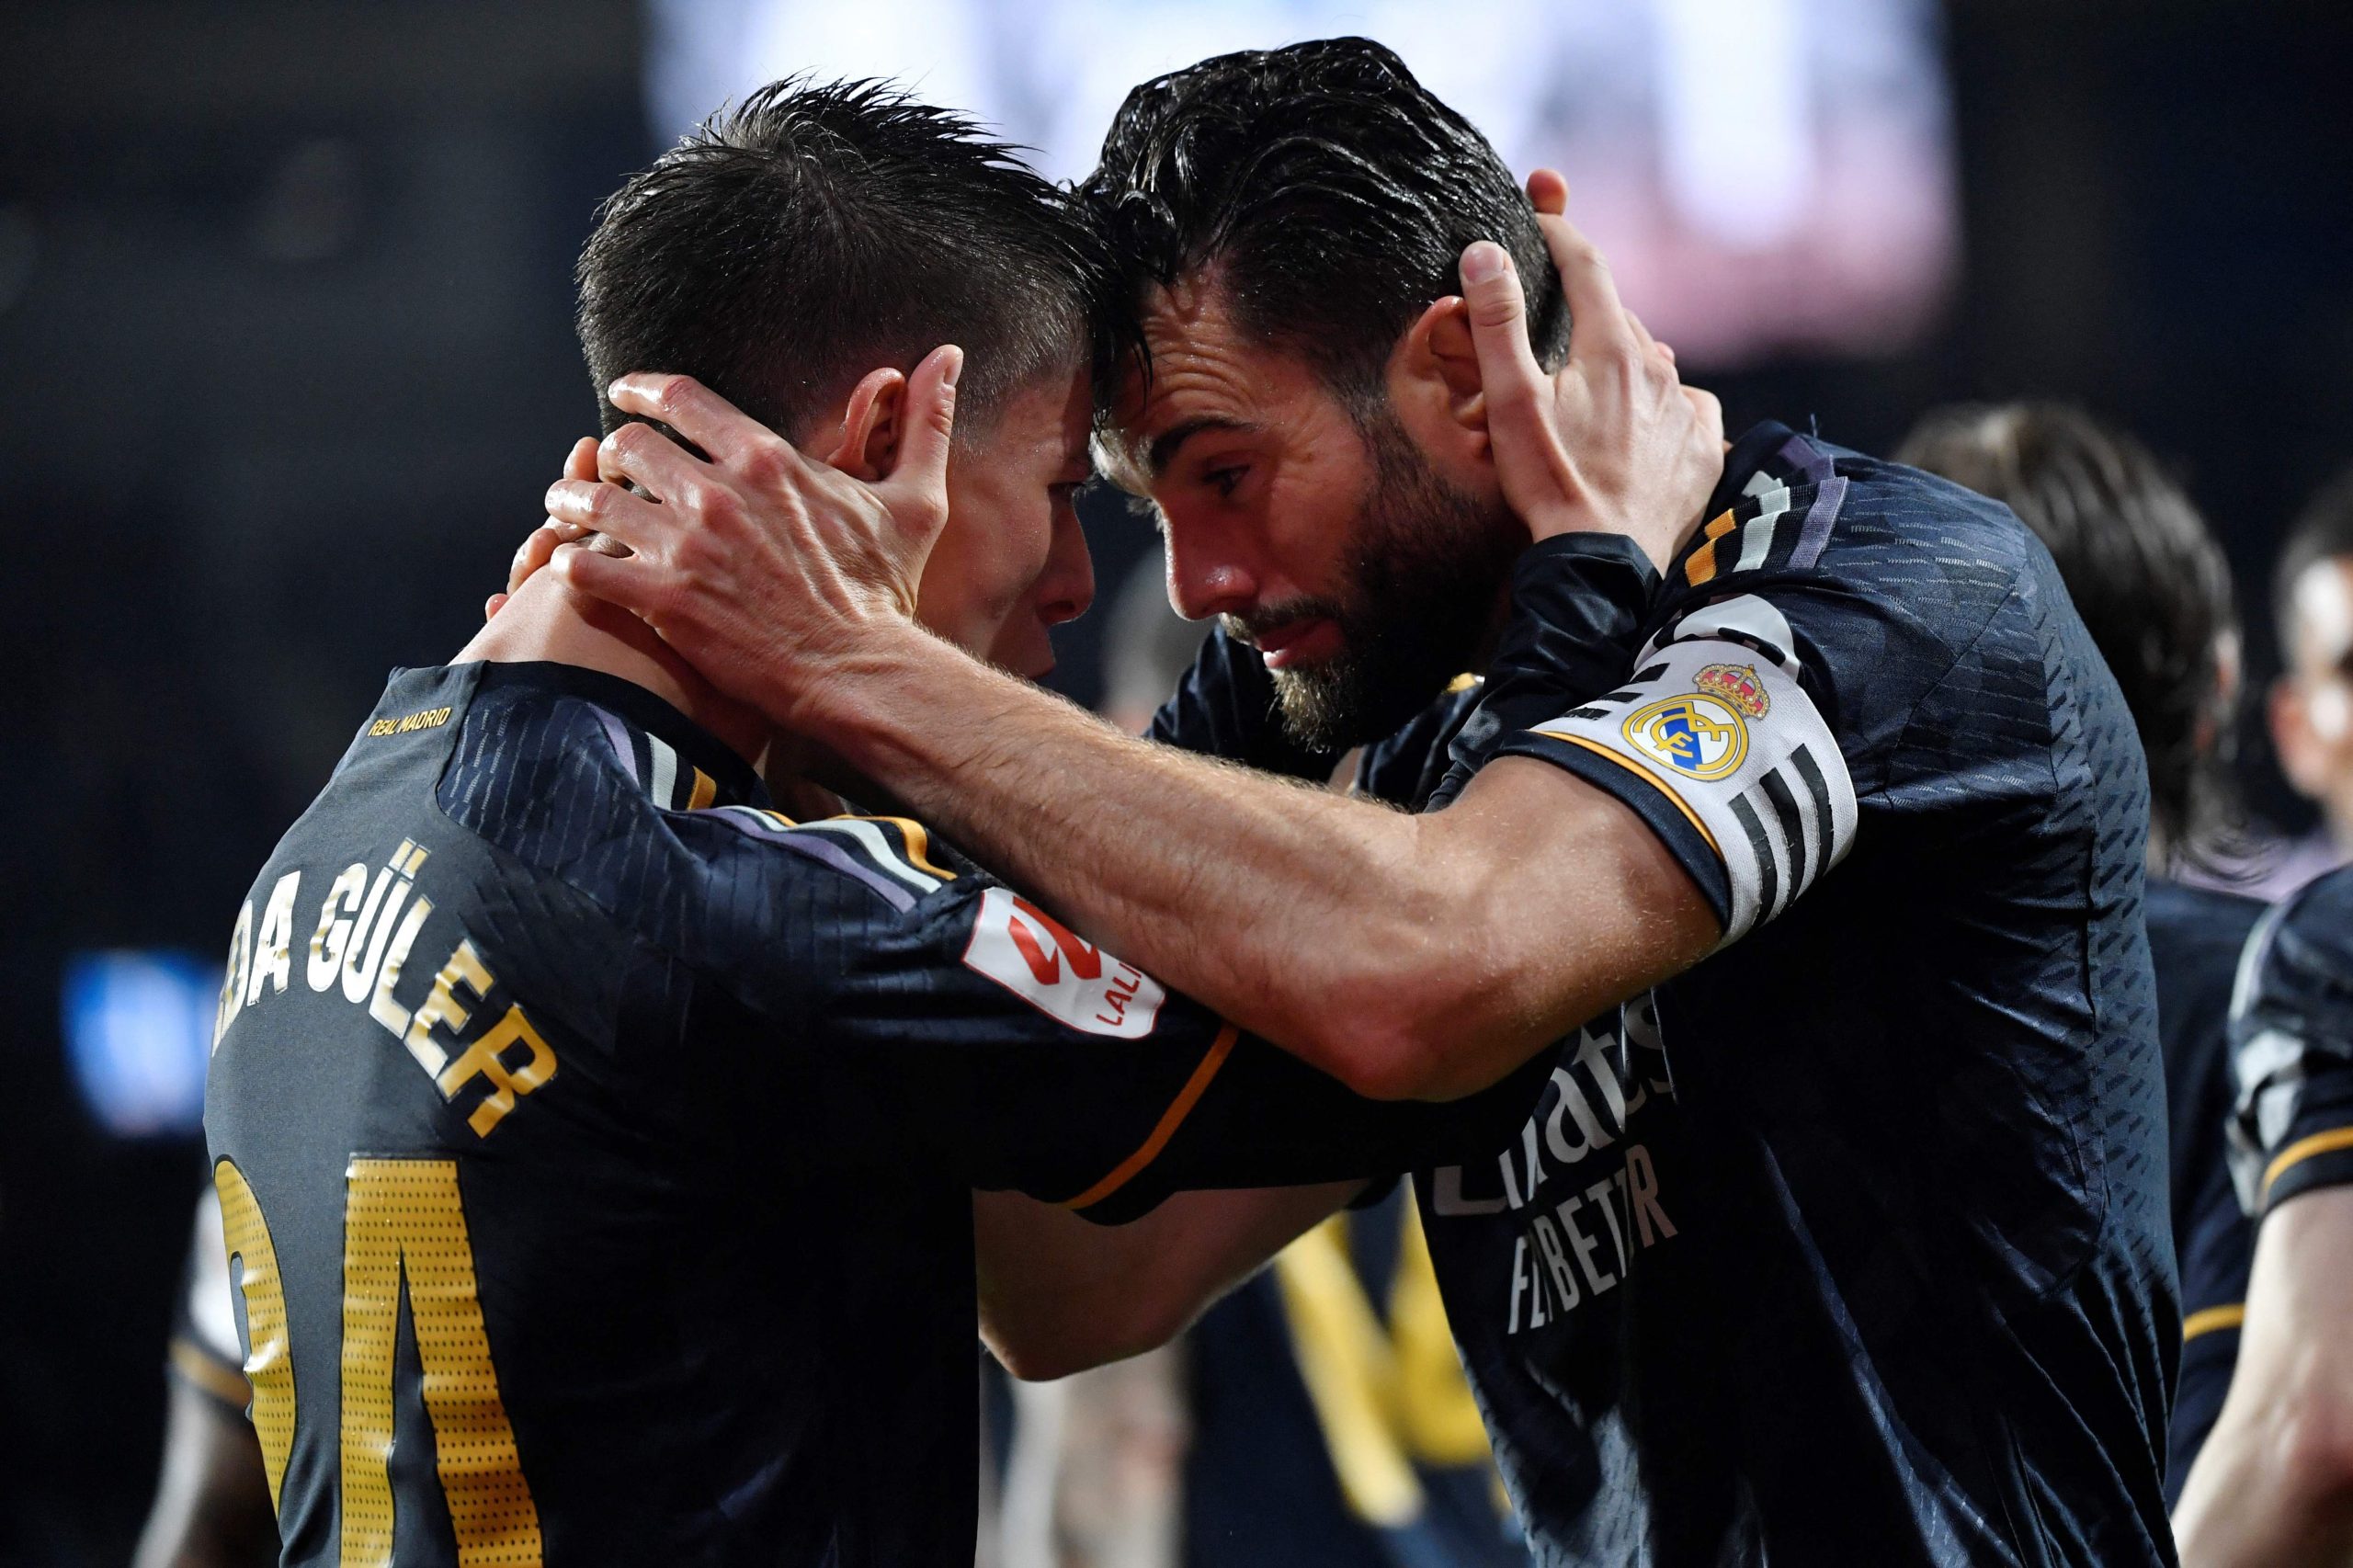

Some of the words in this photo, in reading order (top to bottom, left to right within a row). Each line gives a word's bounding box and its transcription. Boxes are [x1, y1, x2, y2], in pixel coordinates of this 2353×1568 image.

[368, 719, 400, 736] REAL
[396, 707, 452, 733] MADRID
[212, 870, 301, 1057] DA
[307, 836, 559, 1140] GÜLER
[1096, 961, 1142, 1027] LALI
